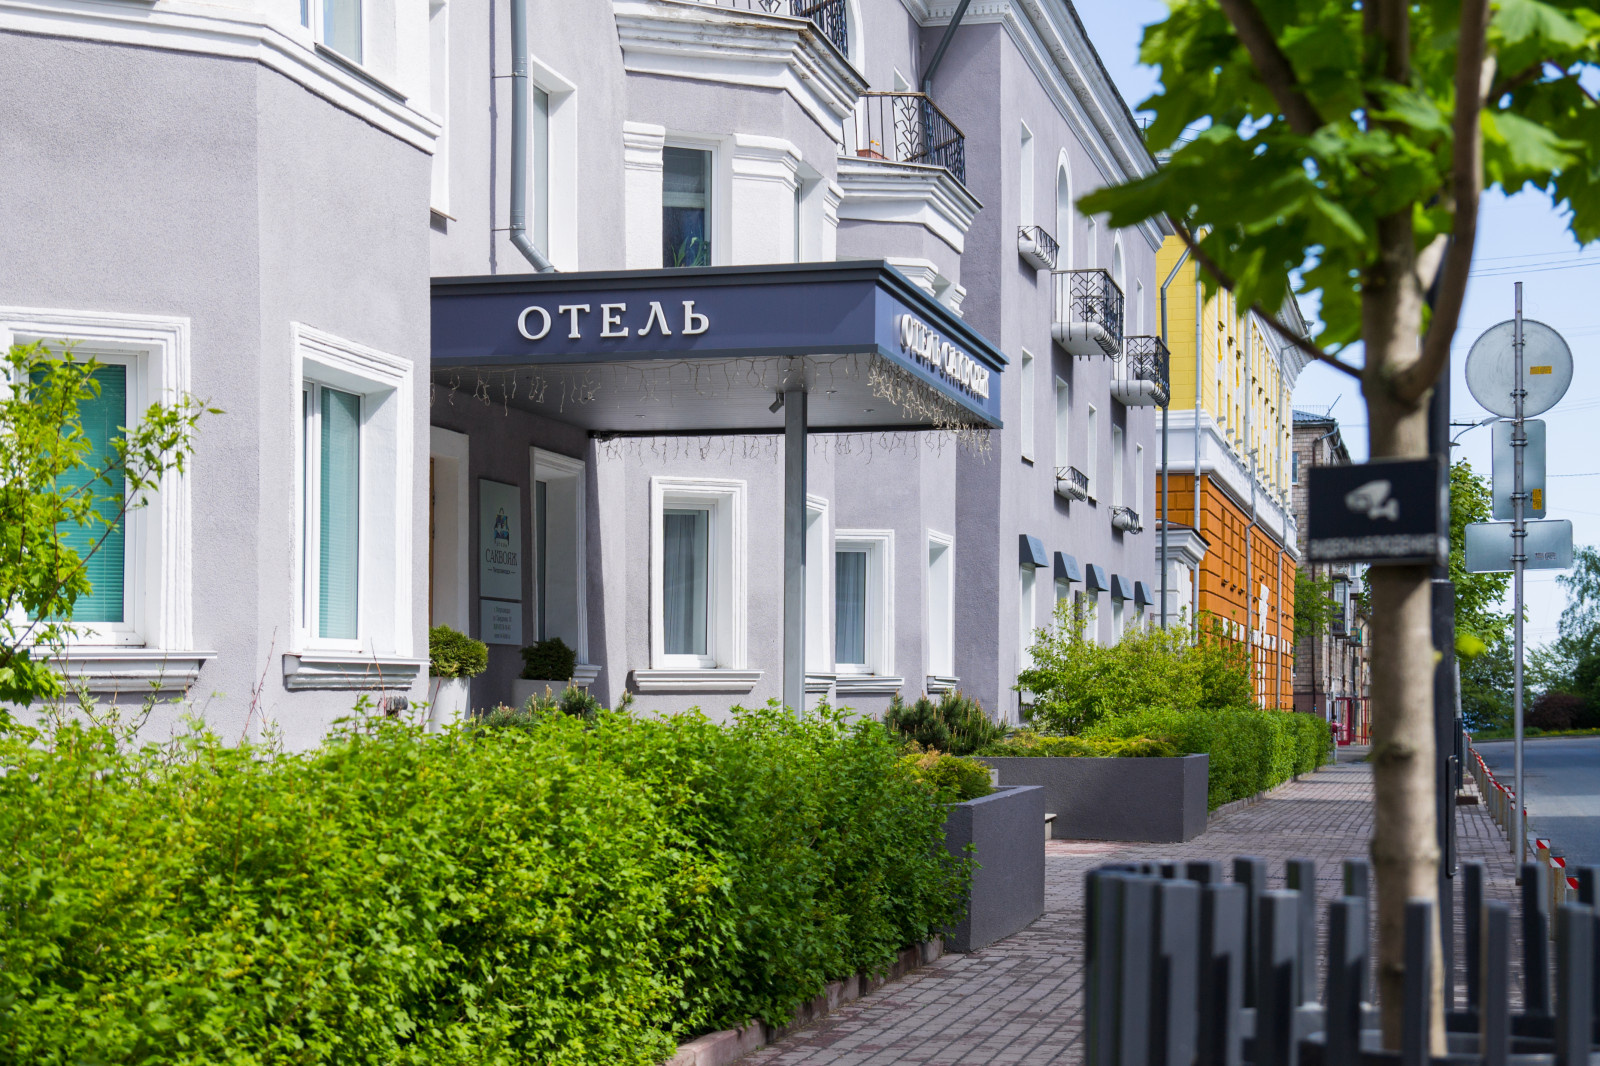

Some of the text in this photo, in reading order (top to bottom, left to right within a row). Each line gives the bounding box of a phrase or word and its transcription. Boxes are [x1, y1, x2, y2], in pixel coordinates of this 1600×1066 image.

[517, 300, 710, 341] ОТЕЛЬ
[900, 313, 990, 400] ОТЕЛЬ САКВОЯЖ
[485, 548, 517, 567] САКВОЯЖ
